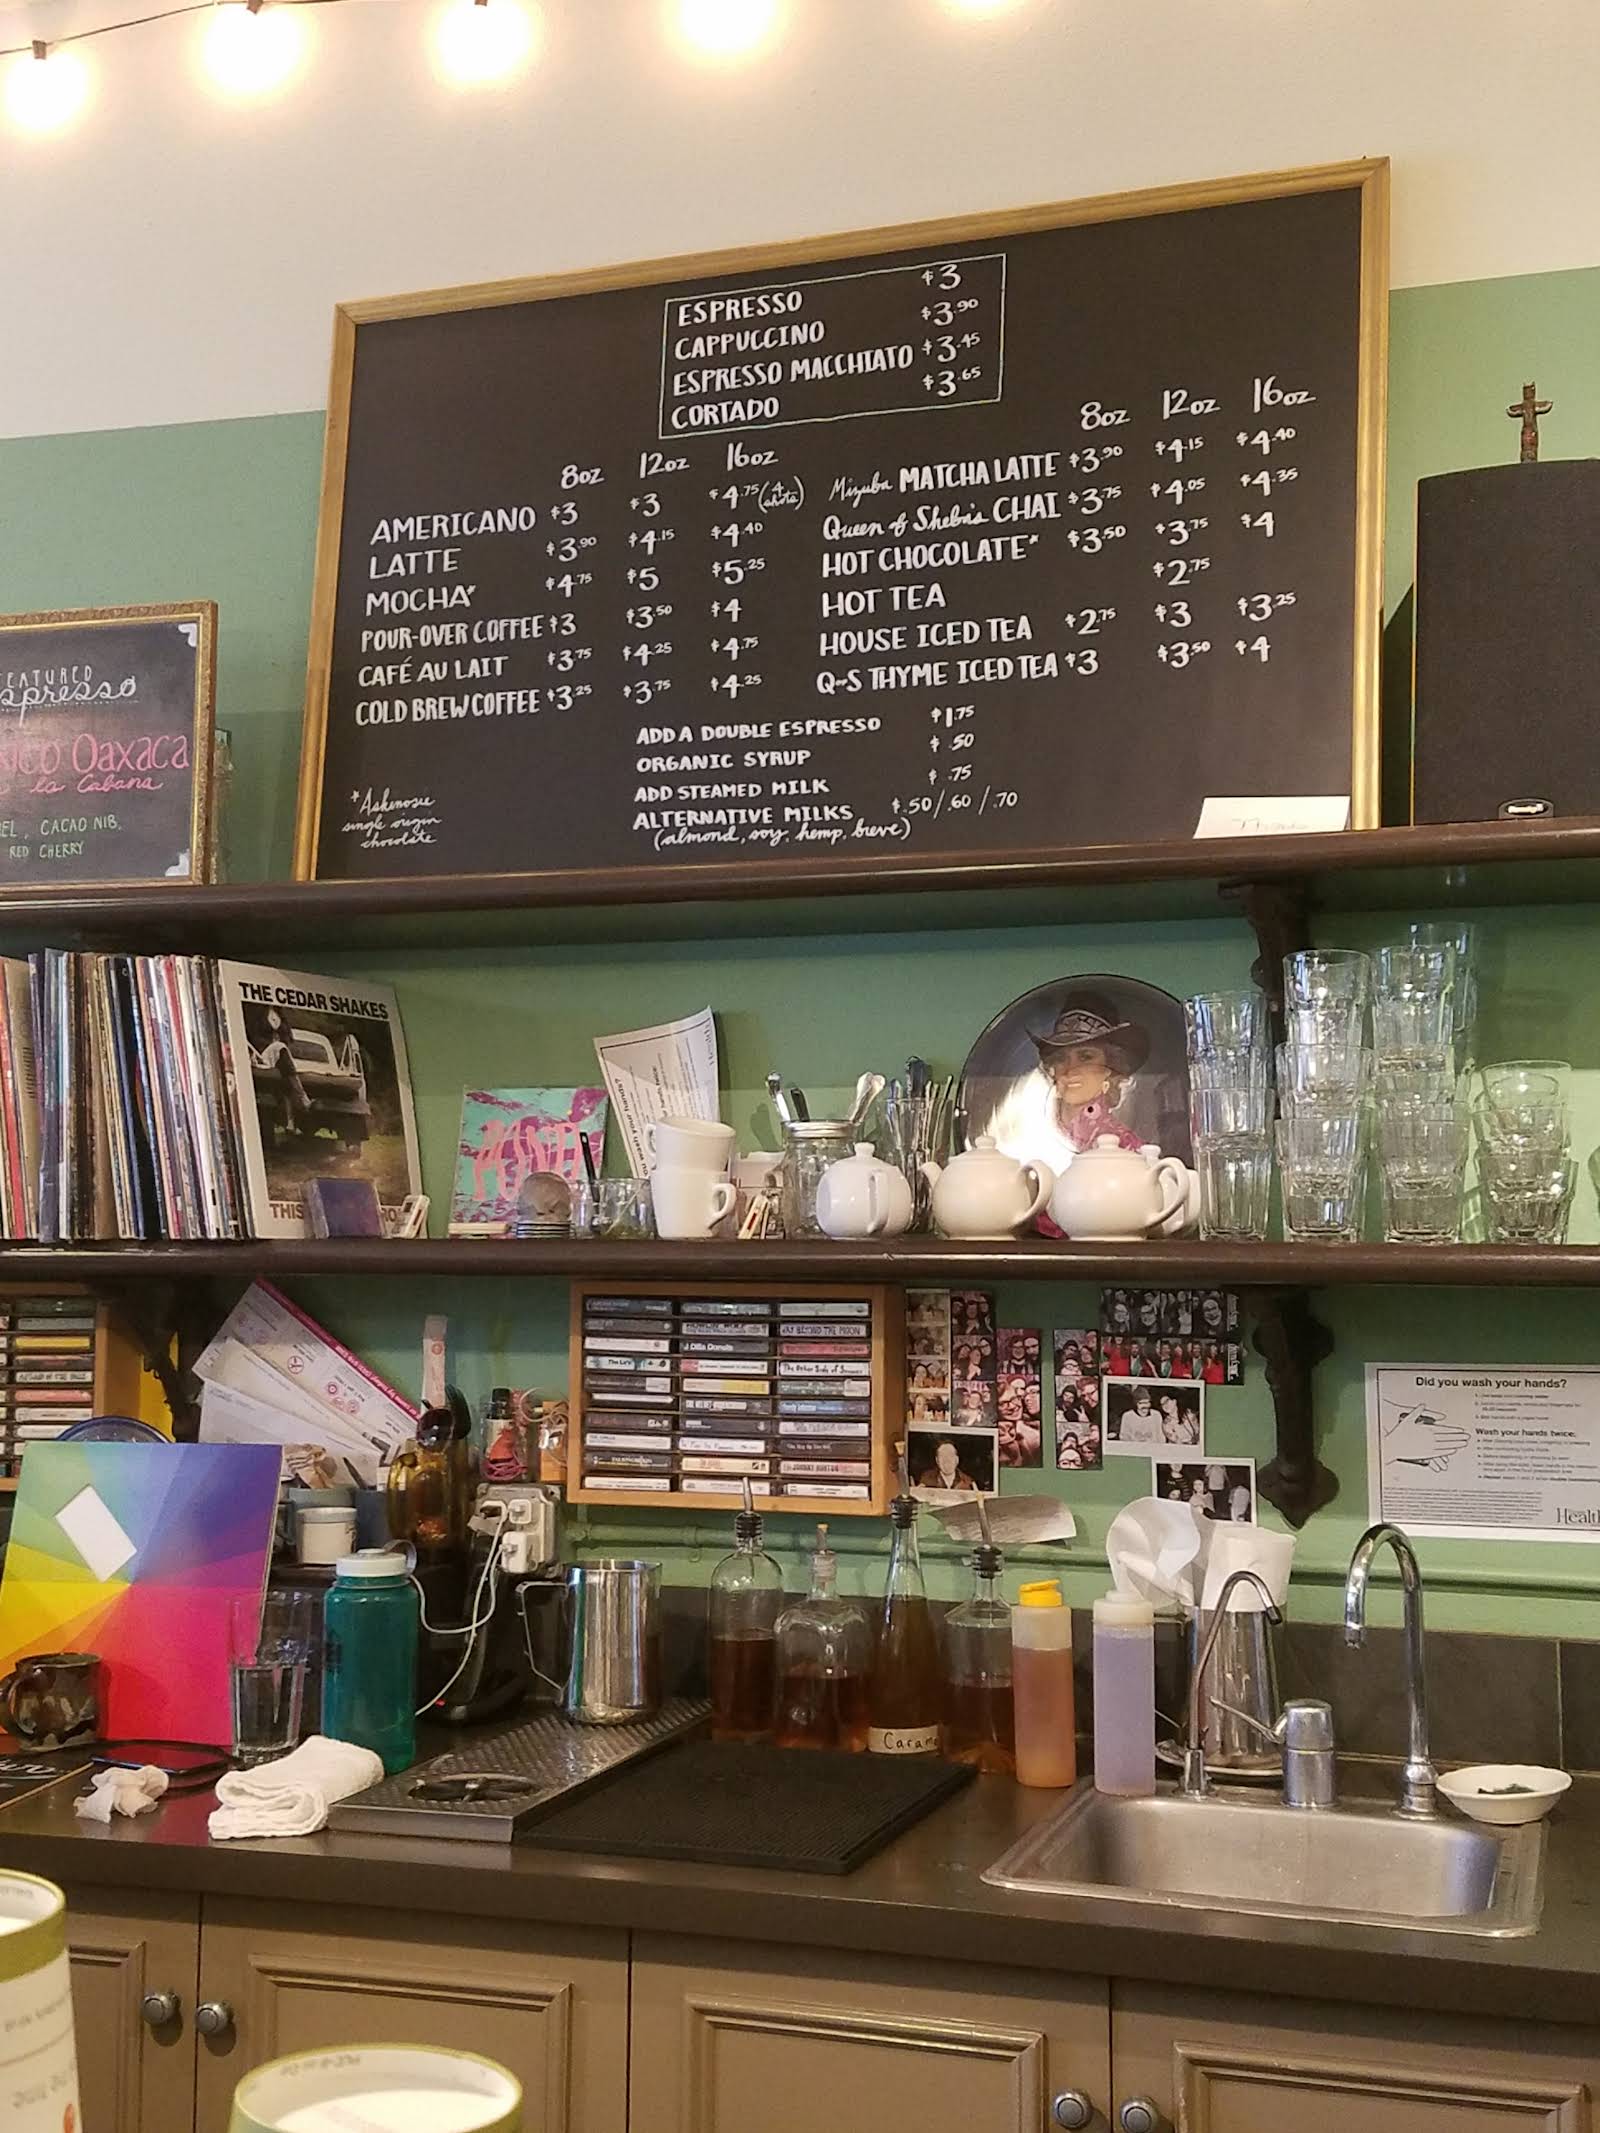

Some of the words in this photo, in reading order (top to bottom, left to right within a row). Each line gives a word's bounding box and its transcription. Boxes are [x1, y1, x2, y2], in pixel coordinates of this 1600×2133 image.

[678, 290, 803, 327] ESPRESSO
[921, 263, 962, 290] $3
[674, 321, 825, 360] CAPPUCCINO
[921, 298, 979, 326] $3.90
[673, 361, 783, 396] ESPRESSO
[790, 344, 914, 382] MACCHIATO
[921, 332, 981, 363] $3.45
[671, 397, 780, 430] CORTADO
[921, 366, 982, 397] $3.65
[1080, 401, 1132, 430] 8oz
[1162, 388, 1221, 420] 12oz
[1253, 375, 1317, 414] 16oz
[561, 465, 604, 489] 8oz
[640, 452, 690, 479] 12oz
[727, 442, 779, 472] 16oz
[829, 471, 893, 508] Mizuba
[899, 460, 990, 493] MATCHA
[994, 452, 1061, 483] LATTE
[1068, 445, 1124, 473] $3.90
[1154, 436, 1204, 464] $4.15
[1236, 427, 1297, 456] $4.40
[370, 506, 536, 545] AMERICANO
[550, 502, 579, 525] $3
[629, 493, 661, 517] $3
[823, 515, 885, 540] Queen
[889, 511, 909, 537] of
[992, 492, 1062, 524] CHAI
[1150, 477, 1206, 505] $4.05
[369, 548, 462, 580] LATTE
[546, 537, 597, 562] $3.90
[628, 529, 675, 555] $4.15
[710, 522, 763, 548] $4.40
[822, 550, 875, 578] HOT
[1066, 525, 1127, 553] $3.50
[1240, 511, 1275, 538] $4
[627, 567, 659, 591] $5
[822, 589, 883, 618] HOT
[889, 582, 947, 611] TEA
[1153, 557, 1211, 586] $2.75
[361, 623, 468, 653] POUR-OVER
[473, 615, 544, 643] COFFEE
[549, 612, 576, 635] $3
[711, 598, 742, 622] $4
[820, 626, 908, 657] HOUSE
[916, 620, 980, 648] ICED
[985, 614, 1033, 642] TEA
[1064, 608, 1117, 635] $2.75
[1154, 601, 1192, 628] $3
[0, 665, 92, 688] EATURED
[358, 656, 412, 687] CAFÉ
[416, 662, 448, 682] AU
[454, 656, 509, 680] LAIT
[867, 661, 949, 691] THYME
[957, 657, 1014, 684] ICED
[1017, 652, 1058, 680] TEA
[1064, 649, 1099, 676] $3
[1157, 641, 1212, 669] $3.50
[1235, 635, 1272, 663] $4
[355, 700, 408, 726] COLD
[412, 694, 469, 722] BREW
[472, 689, 540, 717] COFFEE
[636, 727, 676, 745] ADD
[678, 726, 694, 744] A
[701, 722, 773, 742] DOUBLE
[779, 717, 882, 738] ESPRESSO
[931, 705, 975, 728] $1.75
[73, 733, 189, 773] Oaxaca
[636, 754, 734, 773] ORGANIC
[744, 750, 812, 768] SYRUP
[31, 776, 66, 794] la
[77, 774, 163, 793] Cabana
[633, 786, 673, 803] ADD
[677, 783, 762, 801] STEAMED
[771, 778, 831, 795] MILK
[41, 817, 87, 836] CACAO
[342, 813, 386, 838] single
[632, 807, 773, 831] ALTERNATIVE
[784, 805, 854, 823] MILKS
[852, 816, 911, 842] breve)
[9, 845, 29, 859] RED
[39, 841, 84, 858] CHERRY
[361, 829, 438, 848] chocolate
[238, 982, 273, 1003] THE
[275, 987, 328, 1011] CEDAR
[330, 996, 388, 1020] SHAKES
[269, 1203, 304, 1220] THIS
[1416, 1376, 1434, 1387] Did
[1438, 1378, 1459, 1388] you
[1462, 1377, 1492, 1387] wash
[1495, 1379, 1521, 1389] your
[1524, 1379, 1567, 1389] hands?
[1475, 1428, 1499, 1436] Wash
[1501, 1429, 1520, 1437] your
[1521, 1429, 1548, 1437] hands
[1556, 1507, 1600, 1524] Healt
